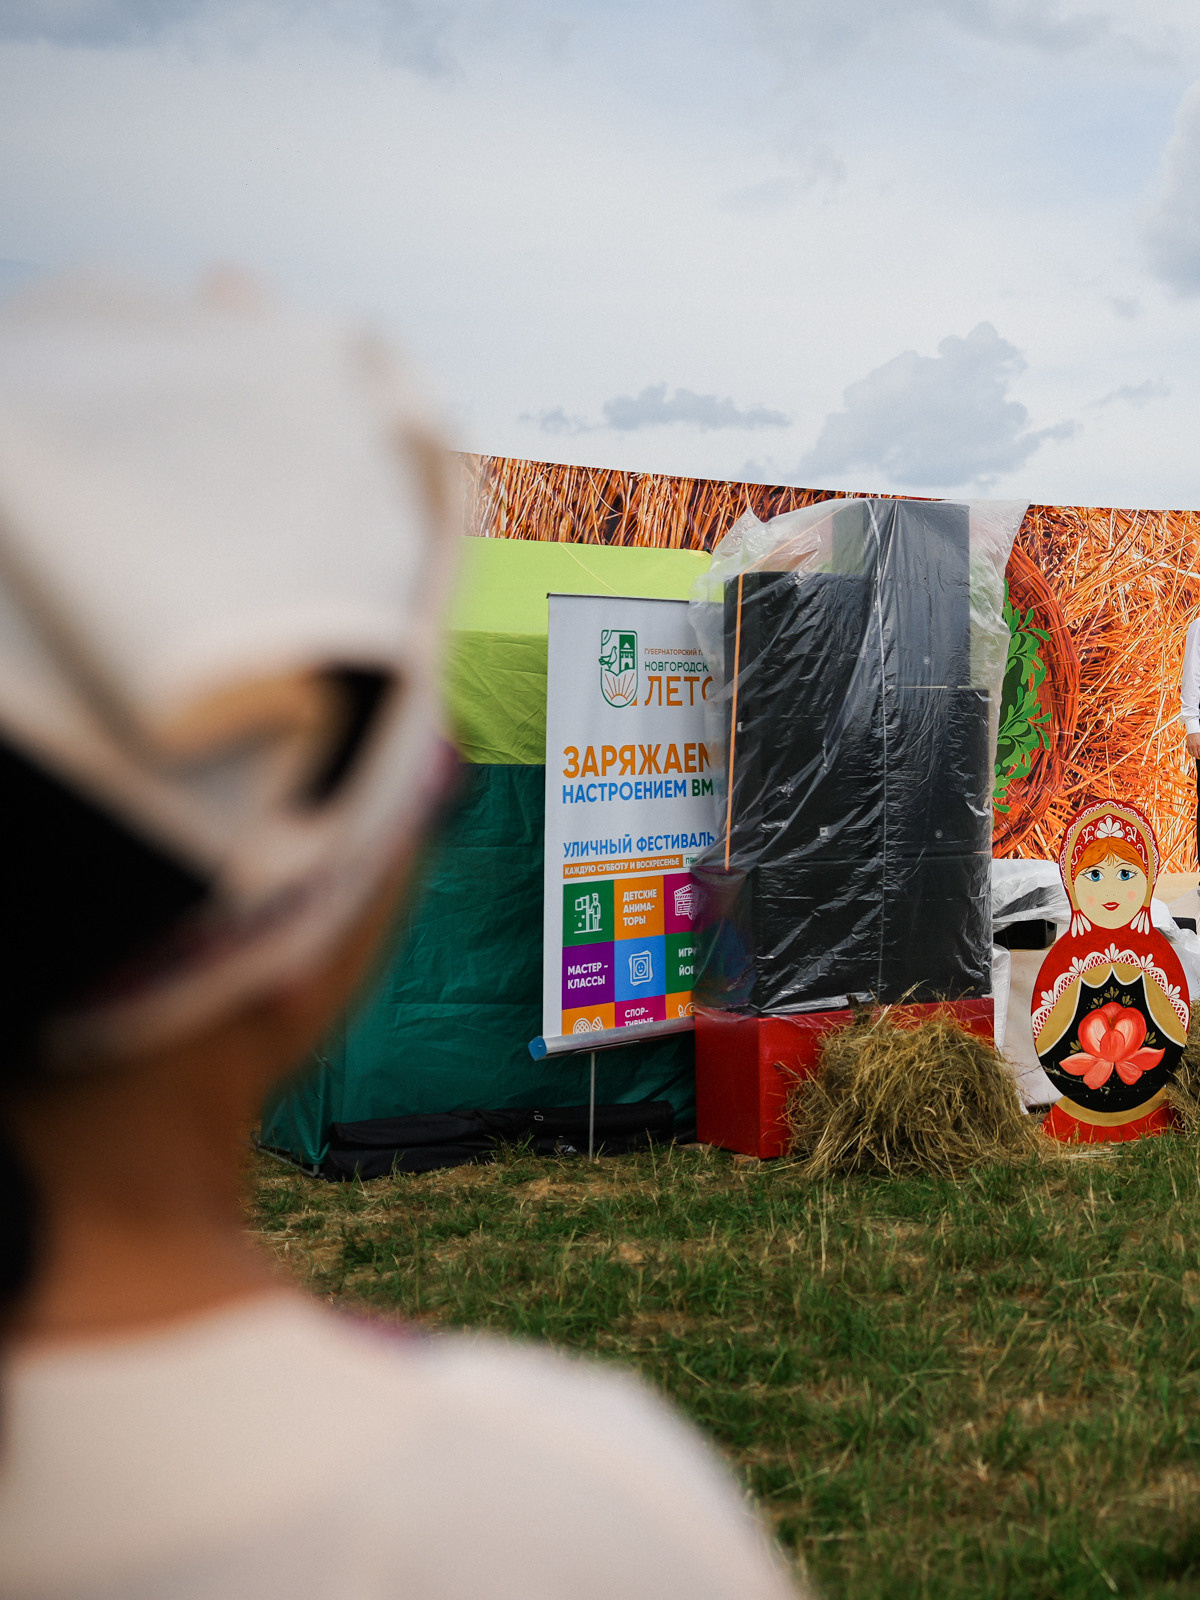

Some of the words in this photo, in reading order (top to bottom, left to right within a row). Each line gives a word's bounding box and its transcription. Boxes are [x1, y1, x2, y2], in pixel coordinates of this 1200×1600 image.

[644, 648, 697, 656] ГУБЕРНАТОРСКИЙ
[644, 661, 709, 673] НОВГОРОДСК
[562, 780, 687, 804] НАСТРОЕНИЕМ
[563, 834, 632, 858] УЛИЧНЫЙ
[636, 832, 715, 852] ФЕСТИВАЛЬ
[564, 863, 597, 876] КАЖДУЮ
[597, 861, 629, 873] СУББОТУ
[629, 861, 636, 869] И
[636, 857, 680, 869] ВОСКРЕСЕНЬЕ
[623, 889, 658, 903] ДЕТСКИЕ
[623, 903, 655, 914] АНИМА-
[623, 916, 646, 926] ТОРЫ
[567, 975, 606, 989] КЛАССЫ
[624, 1007, 649, 1018] СПОР-
